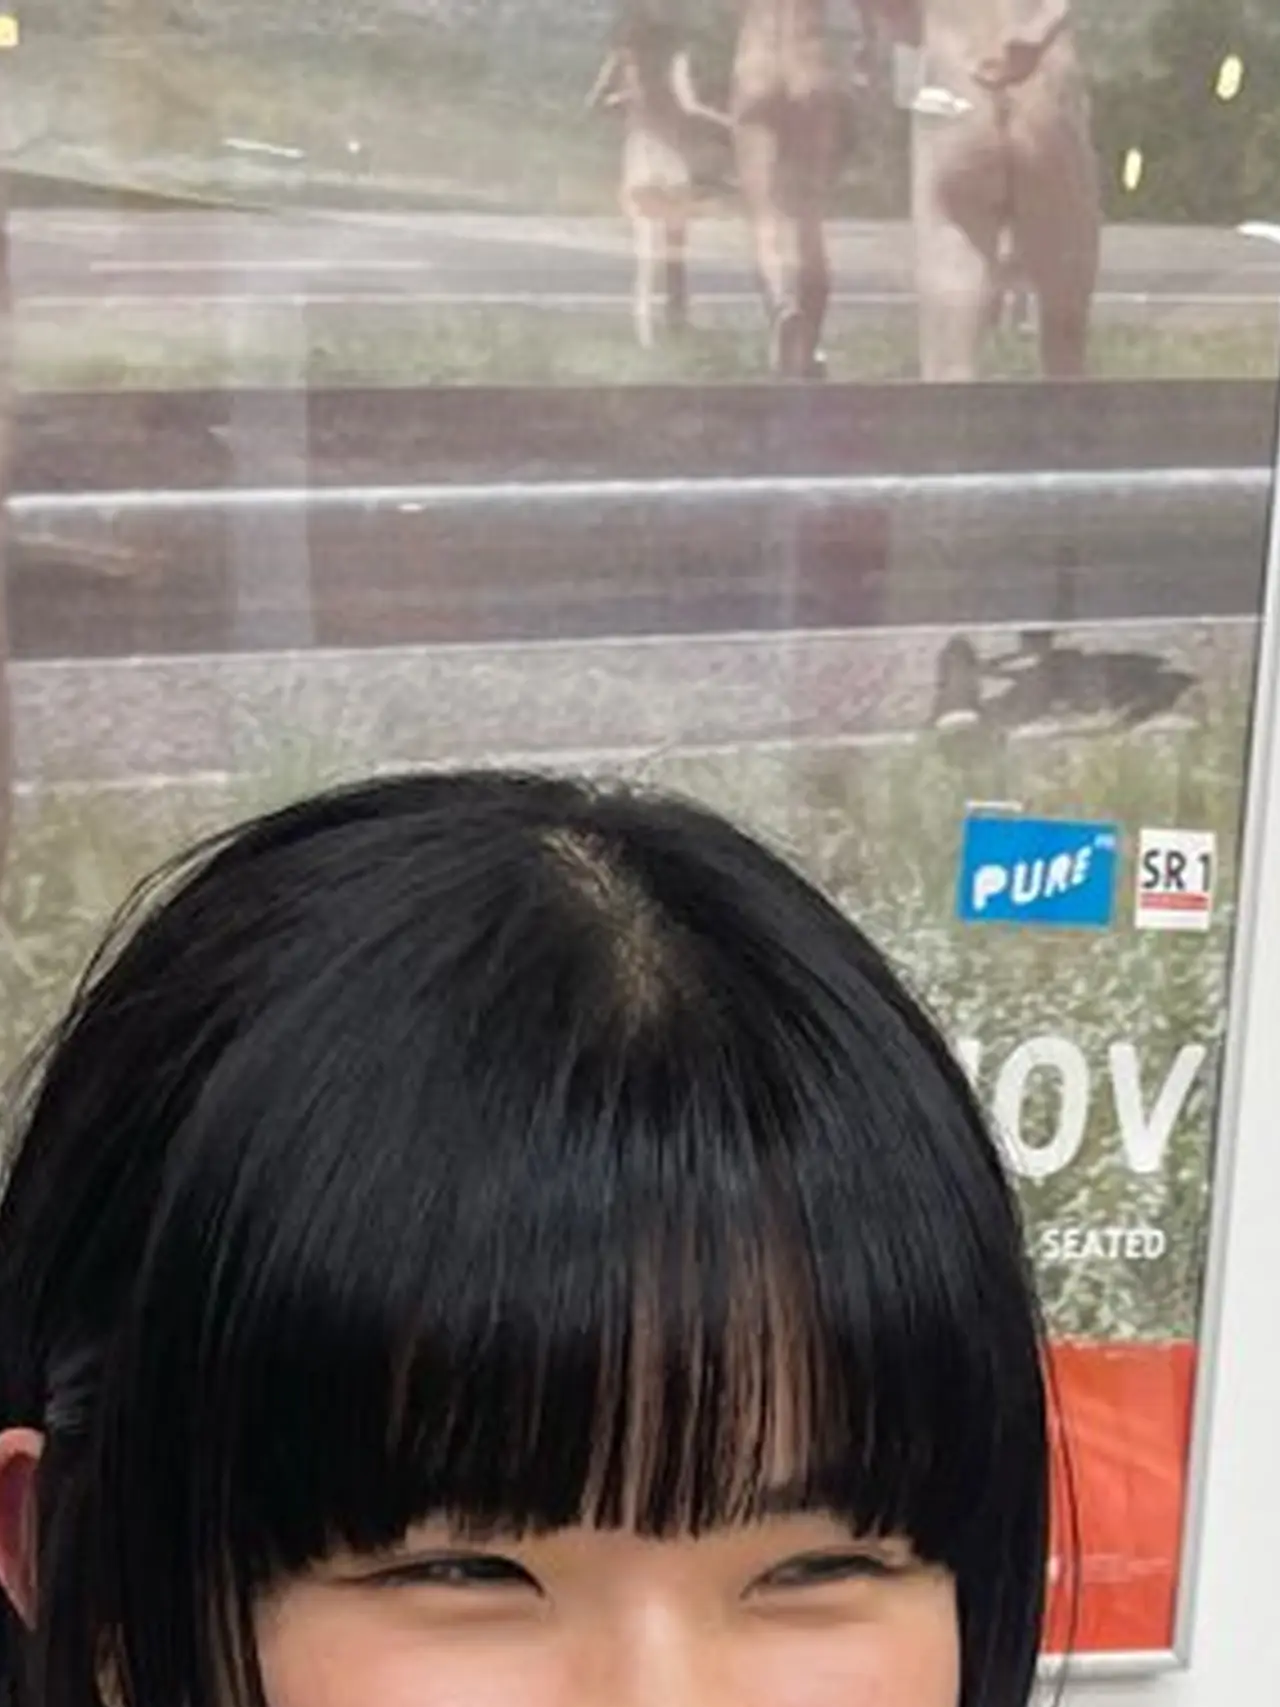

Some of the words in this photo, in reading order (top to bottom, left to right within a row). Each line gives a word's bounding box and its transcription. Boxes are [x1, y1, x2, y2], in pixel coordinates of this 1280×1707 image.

[972, 846, 1093, 911] PURE
[956, 1036, 1207, 1178] OV
[1040, 1228, 1167, 1260] SEATED
